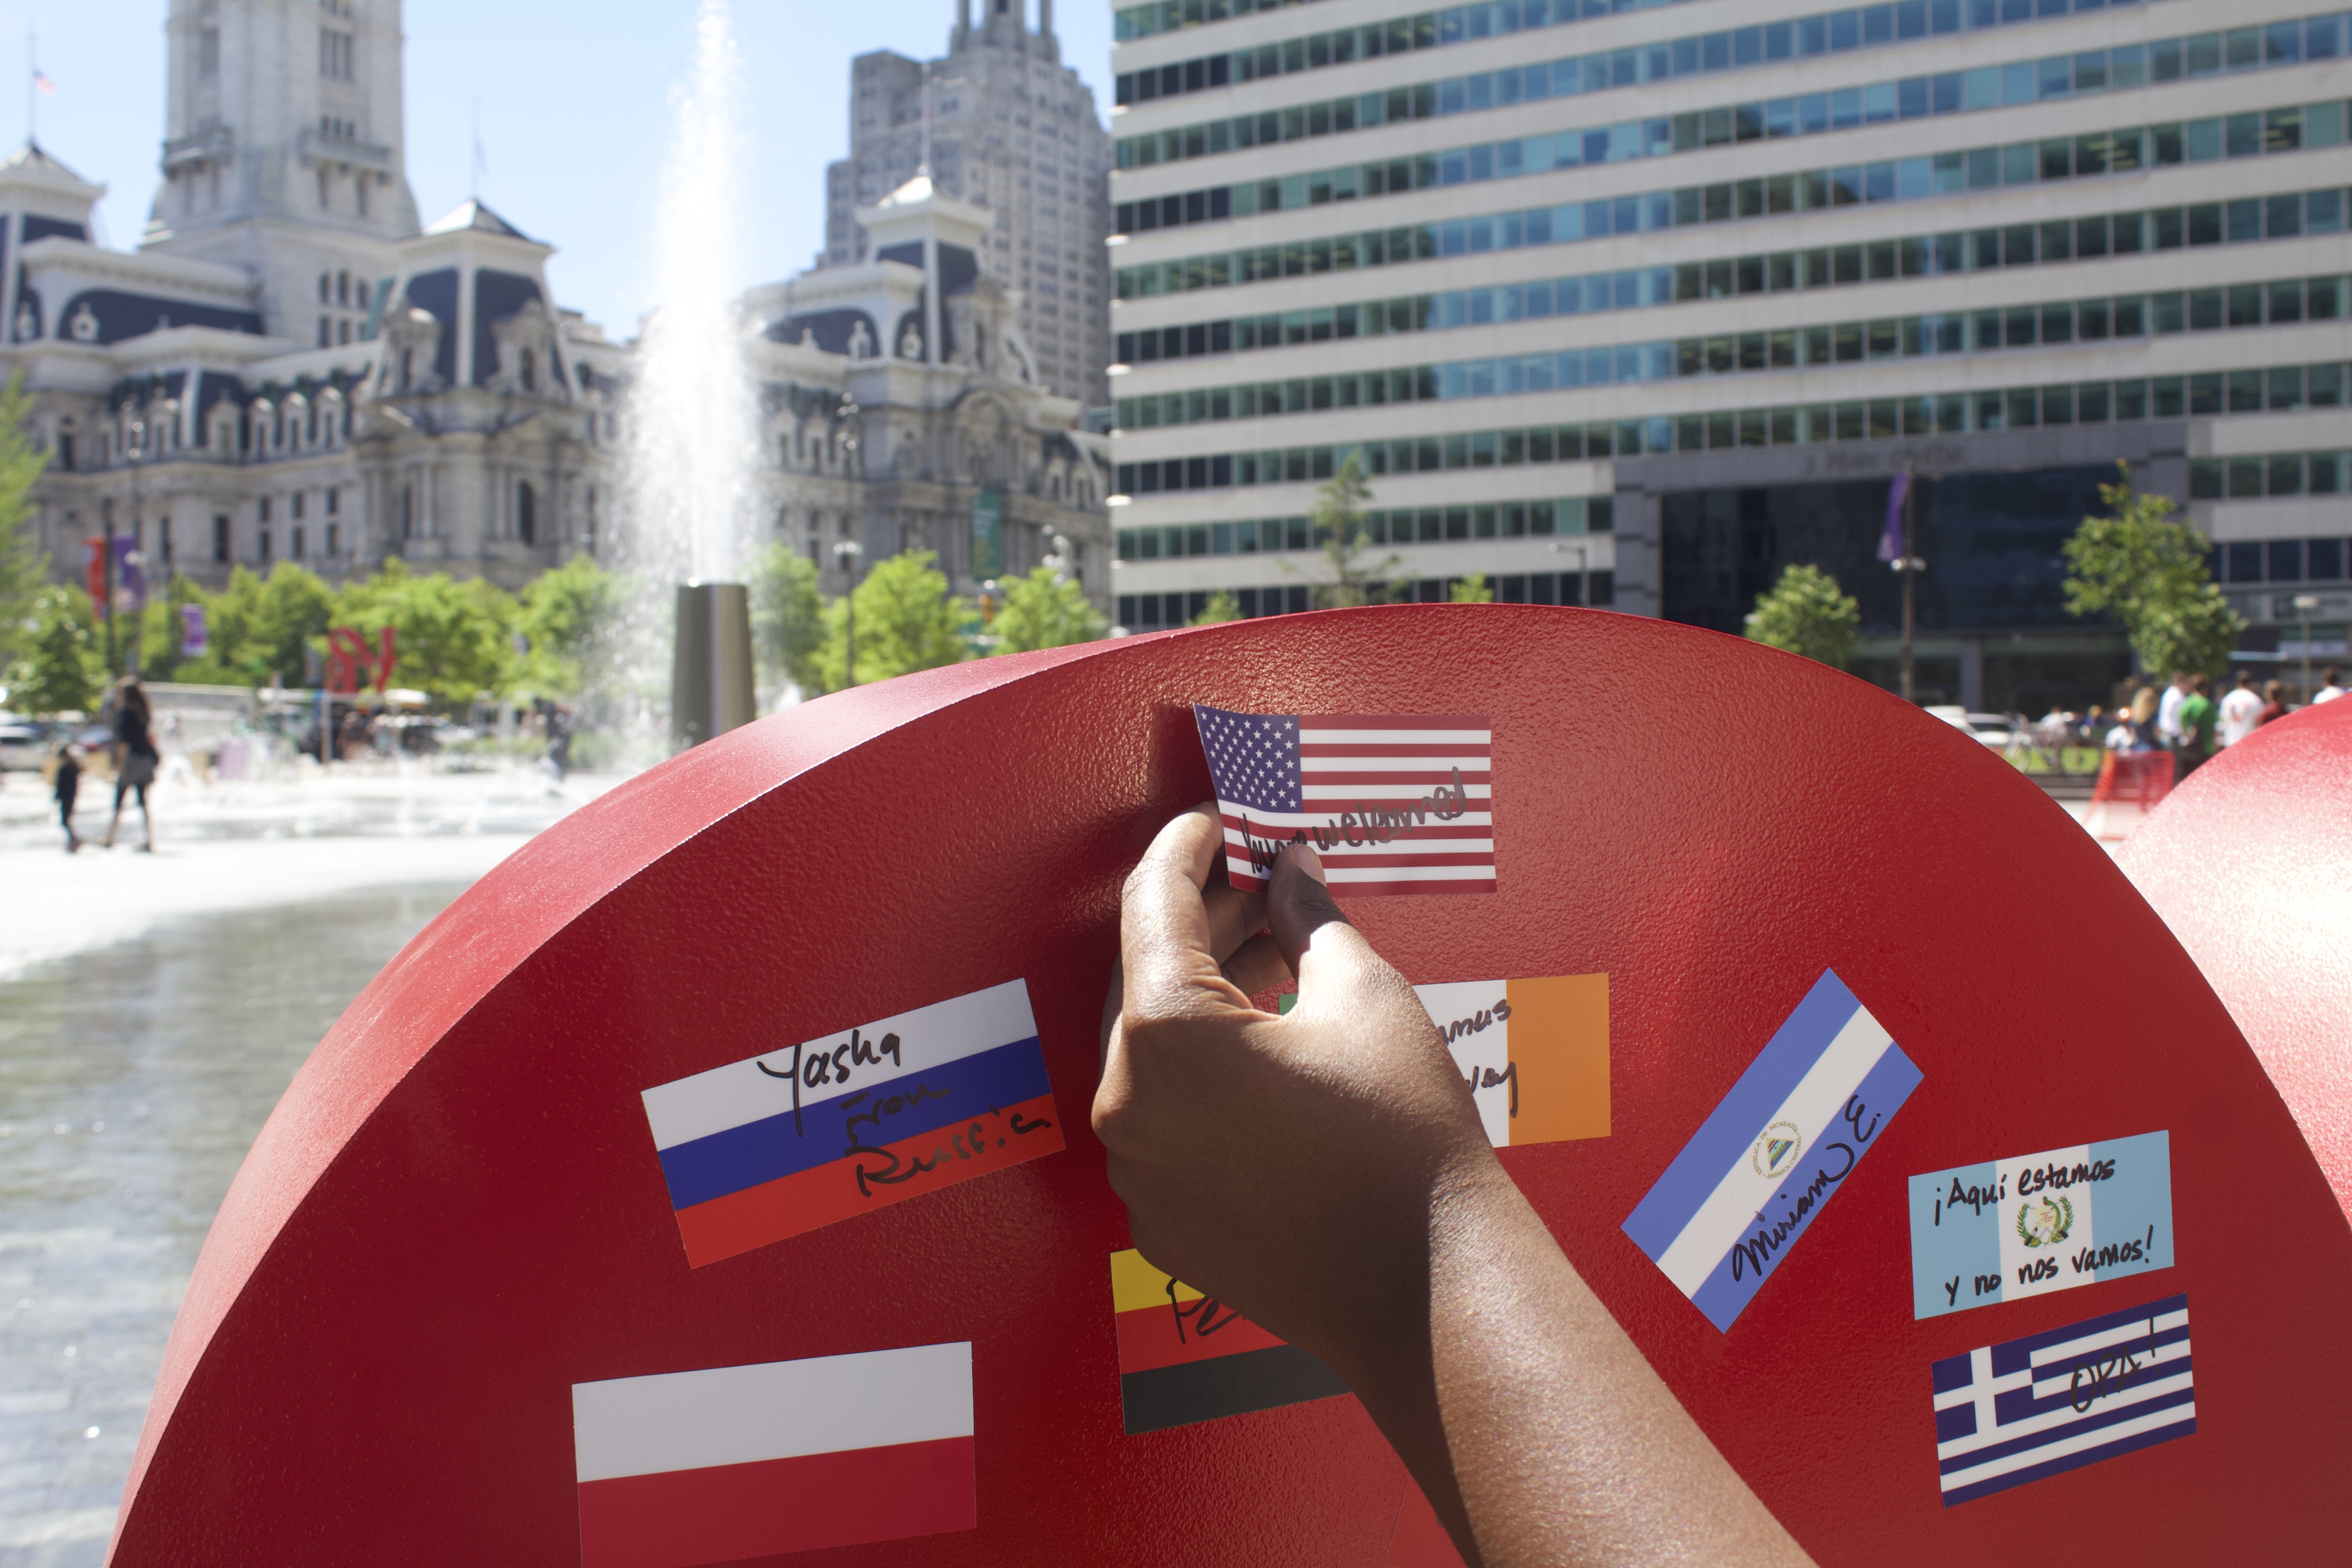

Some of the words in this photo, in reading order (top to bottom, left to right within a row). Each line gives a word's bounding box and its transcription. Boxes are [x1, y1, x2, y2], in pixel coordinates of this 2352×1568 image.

[756, 1029, 901, 1137] Yasha
[1934, 1173, 2007, 1226] ¡Aquí
[2018, 1158, 2116, 1196] estamos
[1974, 1273, 2002, 1296] no
[2019, 1256, 2059, 1284] nos
[2072, 1224, 2153, 1274] vamos!
